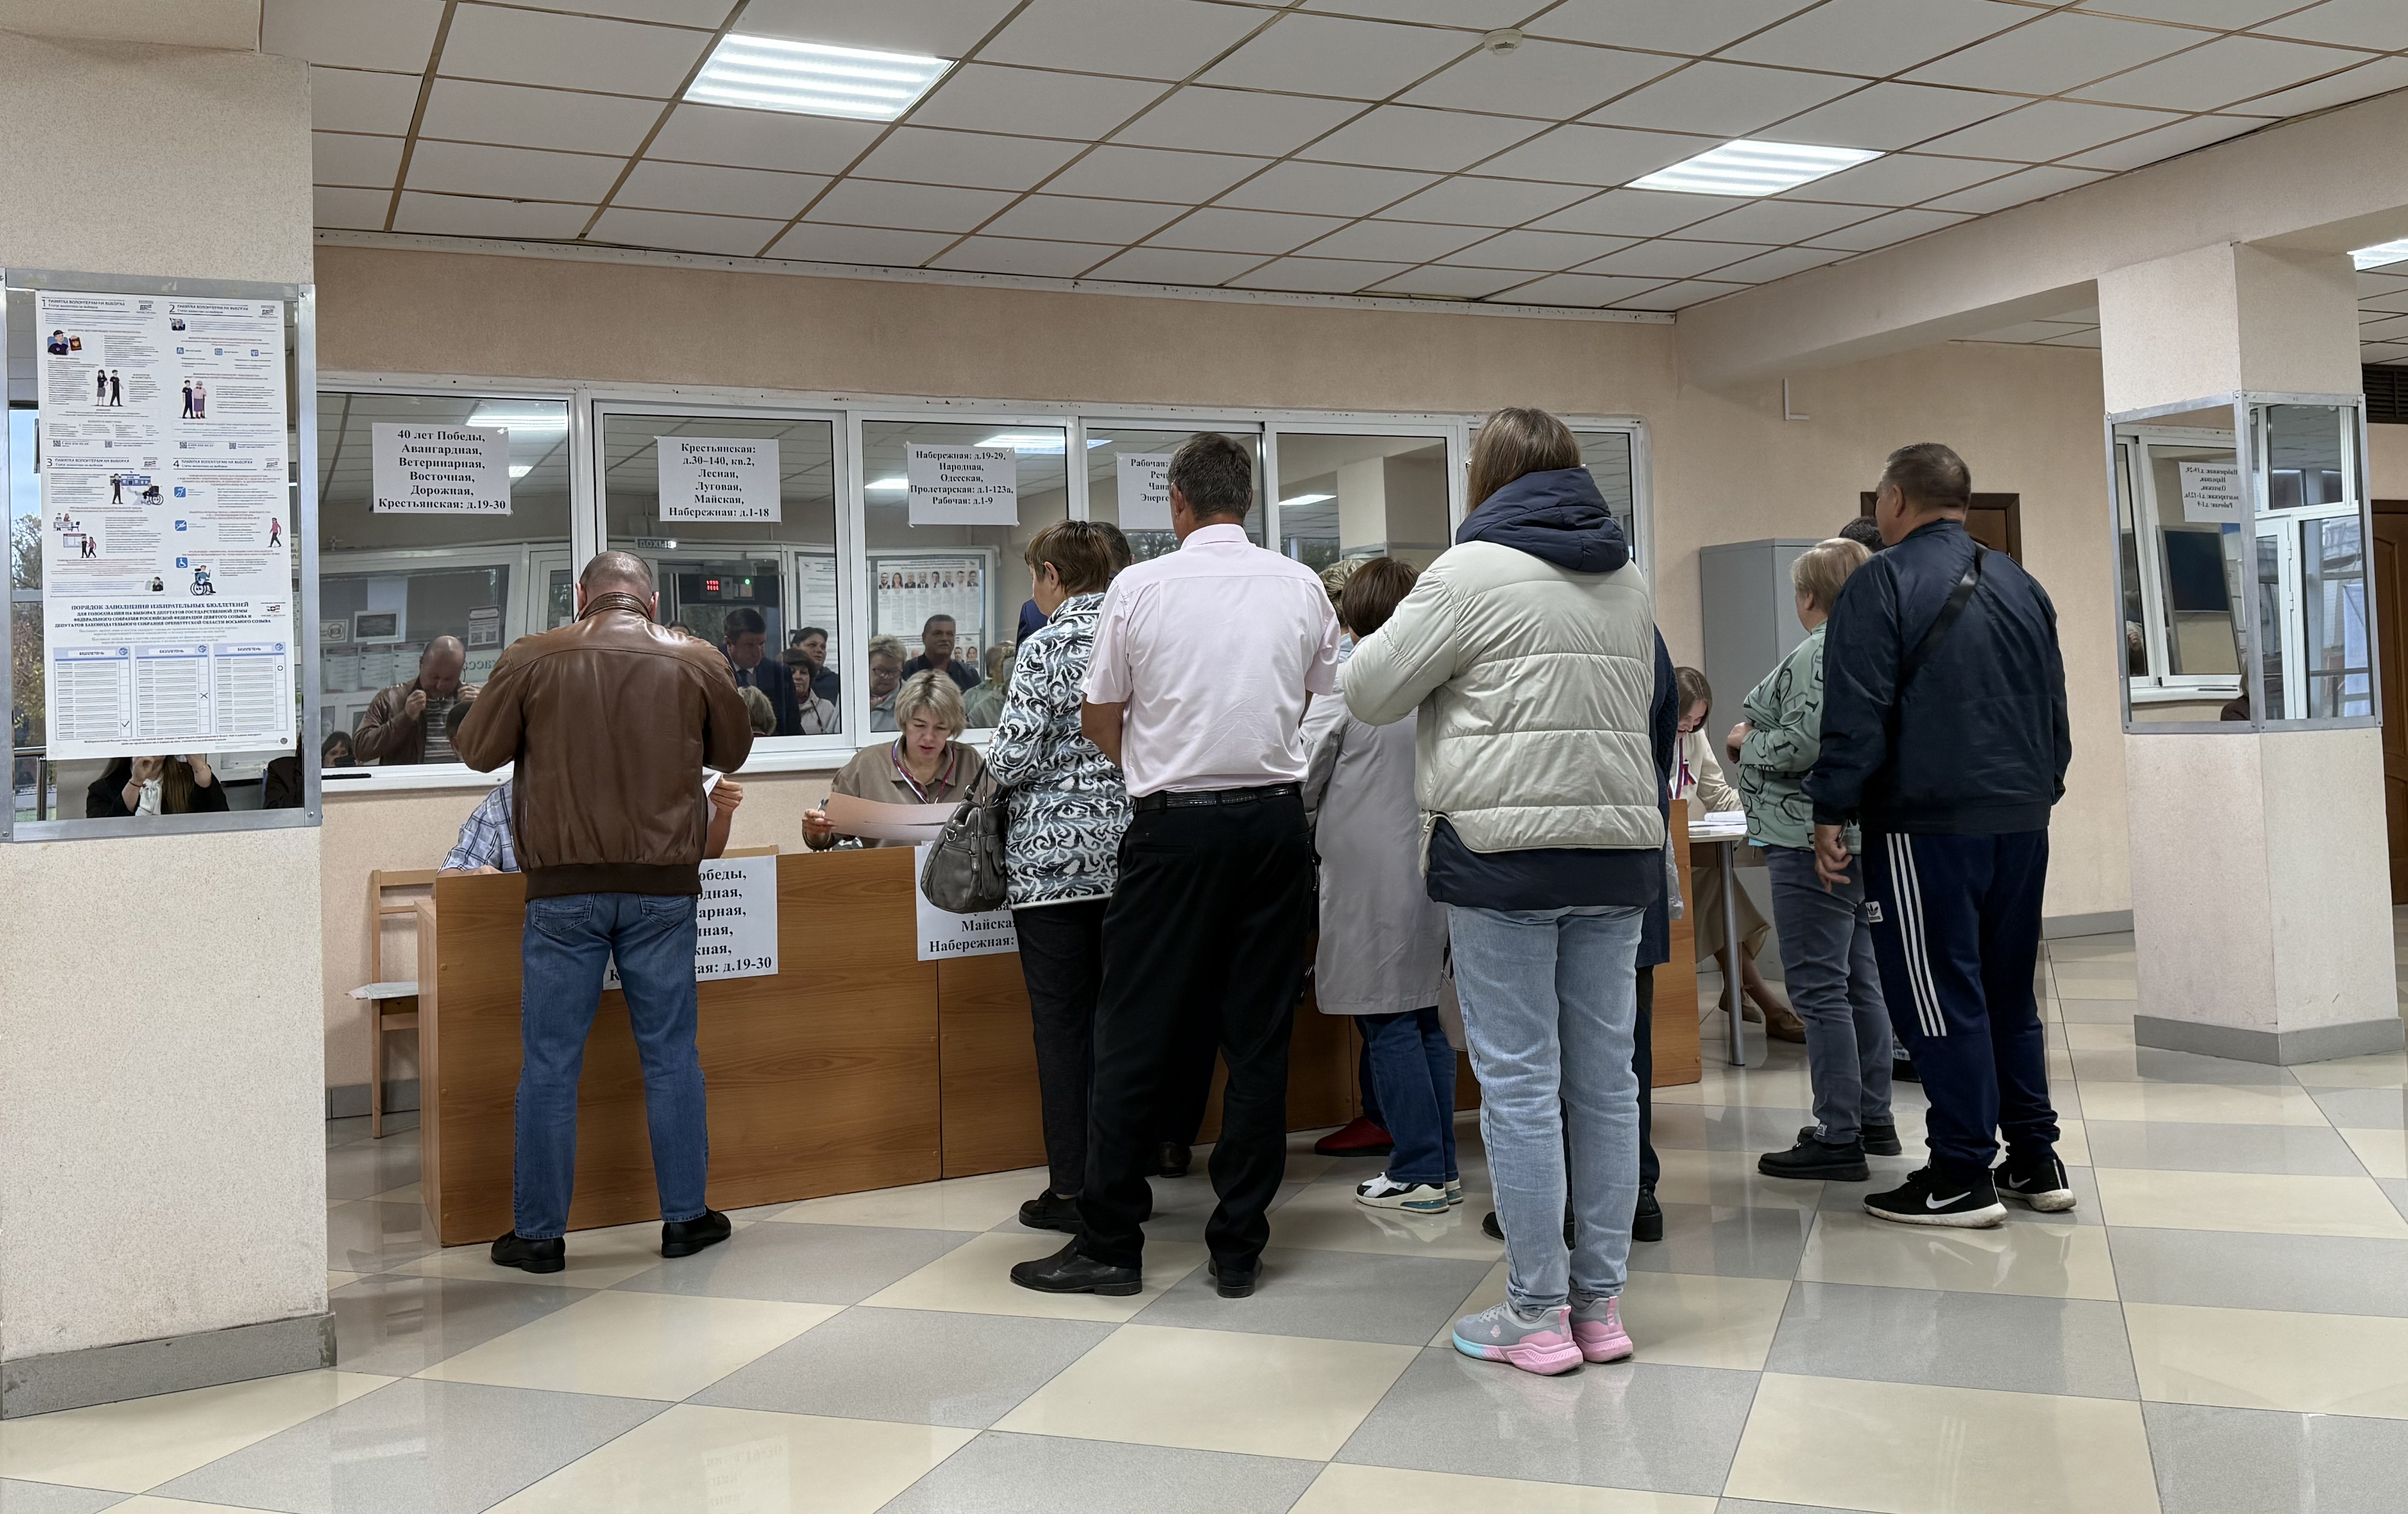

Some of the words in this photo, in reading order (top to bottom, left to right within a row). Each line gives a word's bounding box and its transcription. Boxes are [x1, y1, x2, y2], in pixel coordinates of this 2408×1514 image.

[170, 304, 175, 313] 2
[398, 430, 410, 438] 40
[438, 431, 484, 442] Победы,
[402, 444, 482, 456] Авангардная,
[682, 444, 755, 454] Крестьянская:
[917, 451, 971, 460] Набережная:
[47, 458, 52, 467] 3
[173, 460, 180, 468] 4
[400, 457, 484, 470] Ветеринарная,
[732, 457, 754, 466] кв.2,
[940, 463, 983, 472] Народная,
[411, 472, 474, 483] Восточная,
[699, 469, 738, 479] Лесная,
[941, 474, 983, 482] Одесская,
[411, 485, 473, 497] Дорожная,
[696, 482, 741, 492] Луговая,
[911, 485, 974, 495] Пролетарская:
[379, 499, 463, 509] Крестьянская:
[467, 500, 505, 509] д.19-30
[695, 495, 744, 504] Майская,
[670, 508, 736, 518] Набережная:
[740, 508, 769, 516] д.1-18
[699, 869, 746, 881] обеды,
[930, 936, 1014, 952] Набережная:
[723, 956, 772, 973] д.19-30
